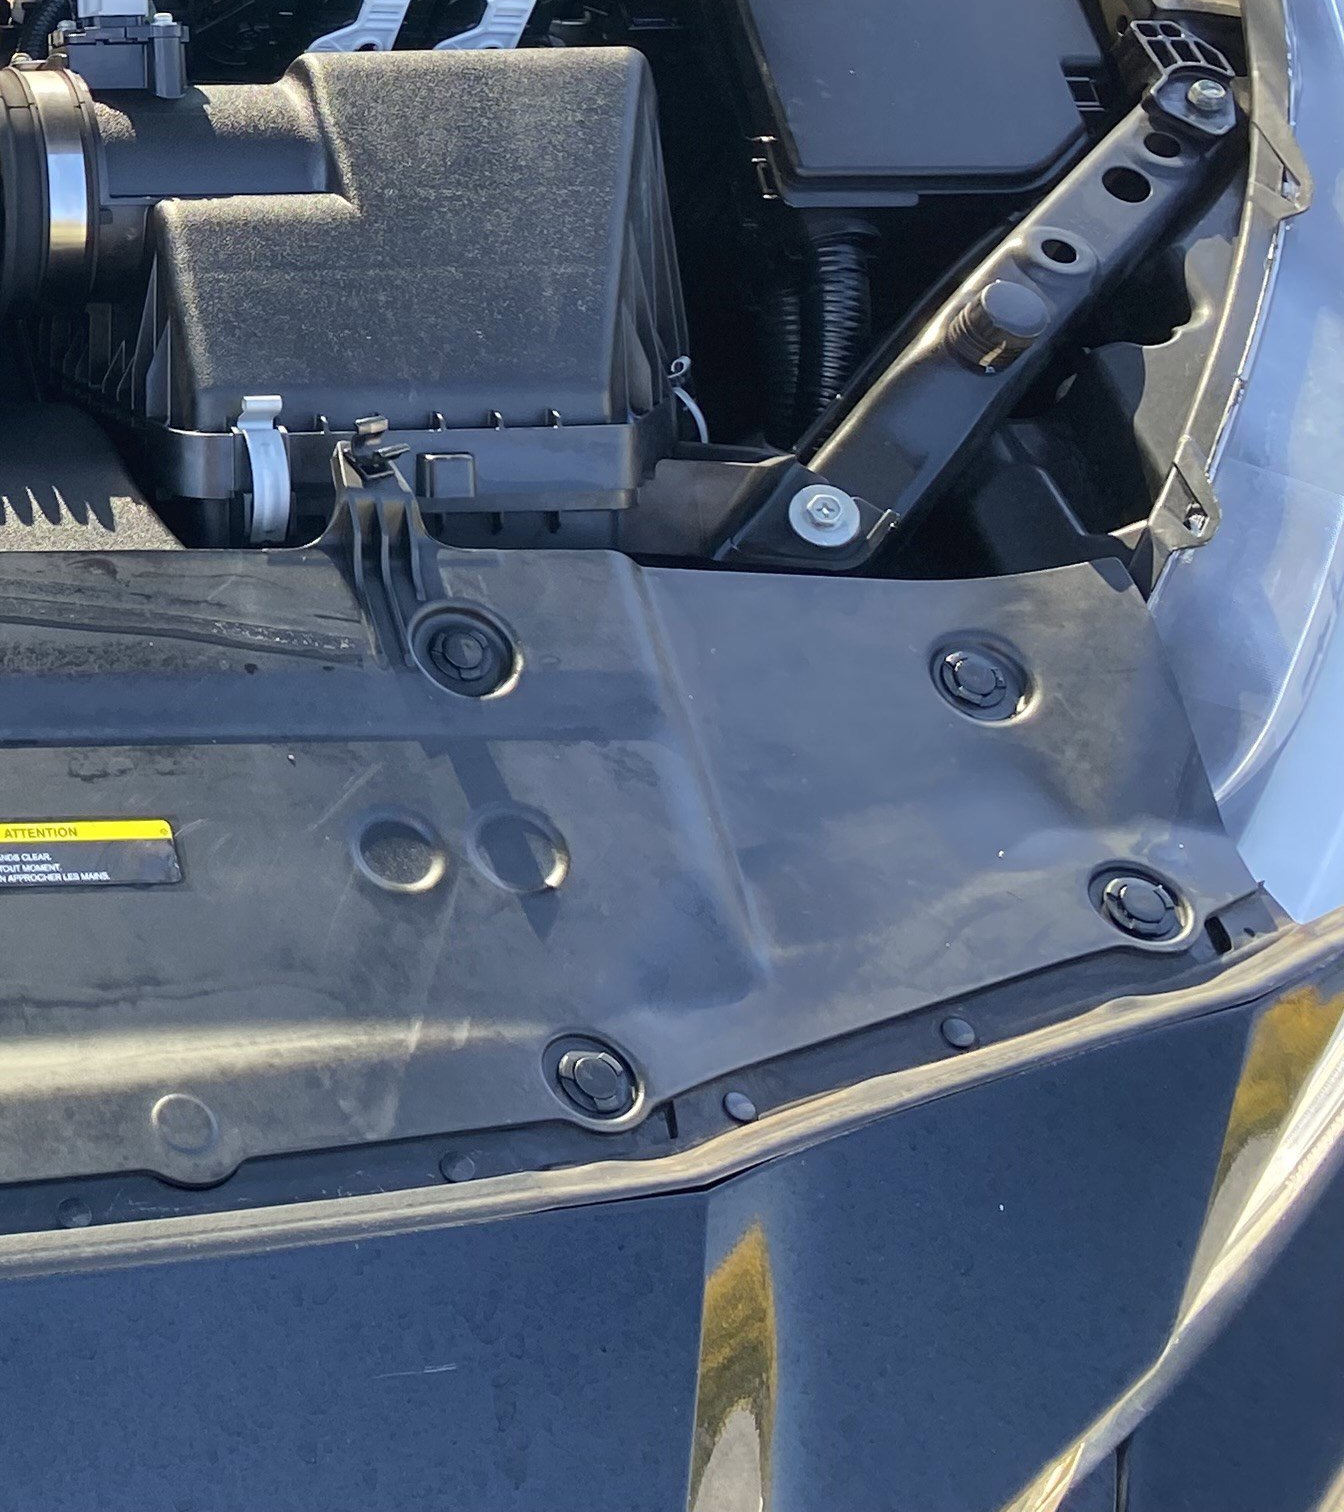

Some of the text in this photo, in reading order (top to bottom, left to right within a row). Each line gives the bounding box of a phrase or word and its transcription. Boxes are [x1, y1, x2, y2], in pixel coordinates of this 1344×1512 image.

[4, 827, 78, 839] ATTENTION
[21, 853, 52, 861] CLEAR.
[22, 863, 62, 872] MOMENT.
[8, 873, 62, 883] APPROCHER
[63, 872, 80, 881] LES
[81, 871, 111, 880] MAINS.
